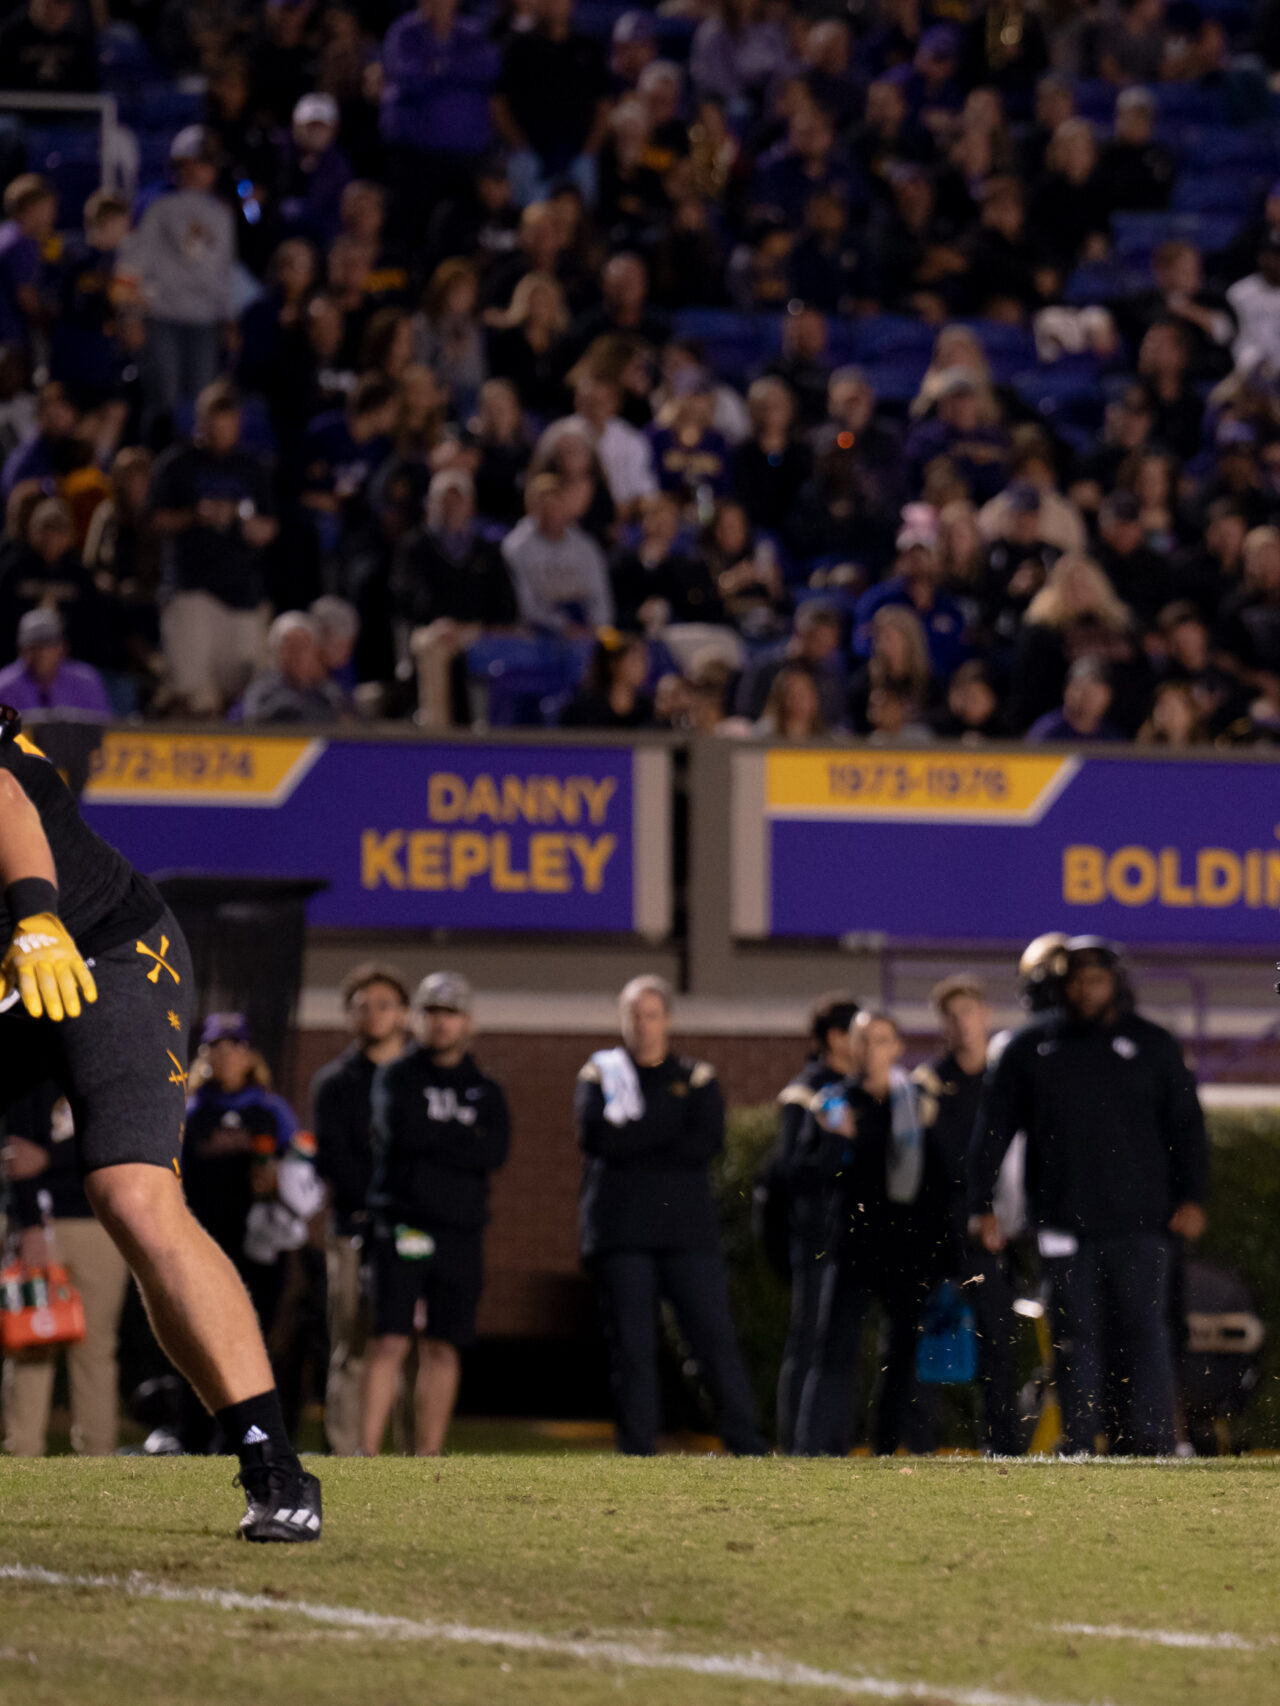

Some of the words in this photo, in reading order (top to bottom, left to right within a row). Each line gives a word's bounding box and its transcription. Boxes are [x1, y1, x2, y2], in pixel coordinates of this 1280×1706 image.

[88, 744, 255, 783] 972-1974
[428, 772, 617, 825] DANNY
[360, 829, 617, 893] KEPLEY
